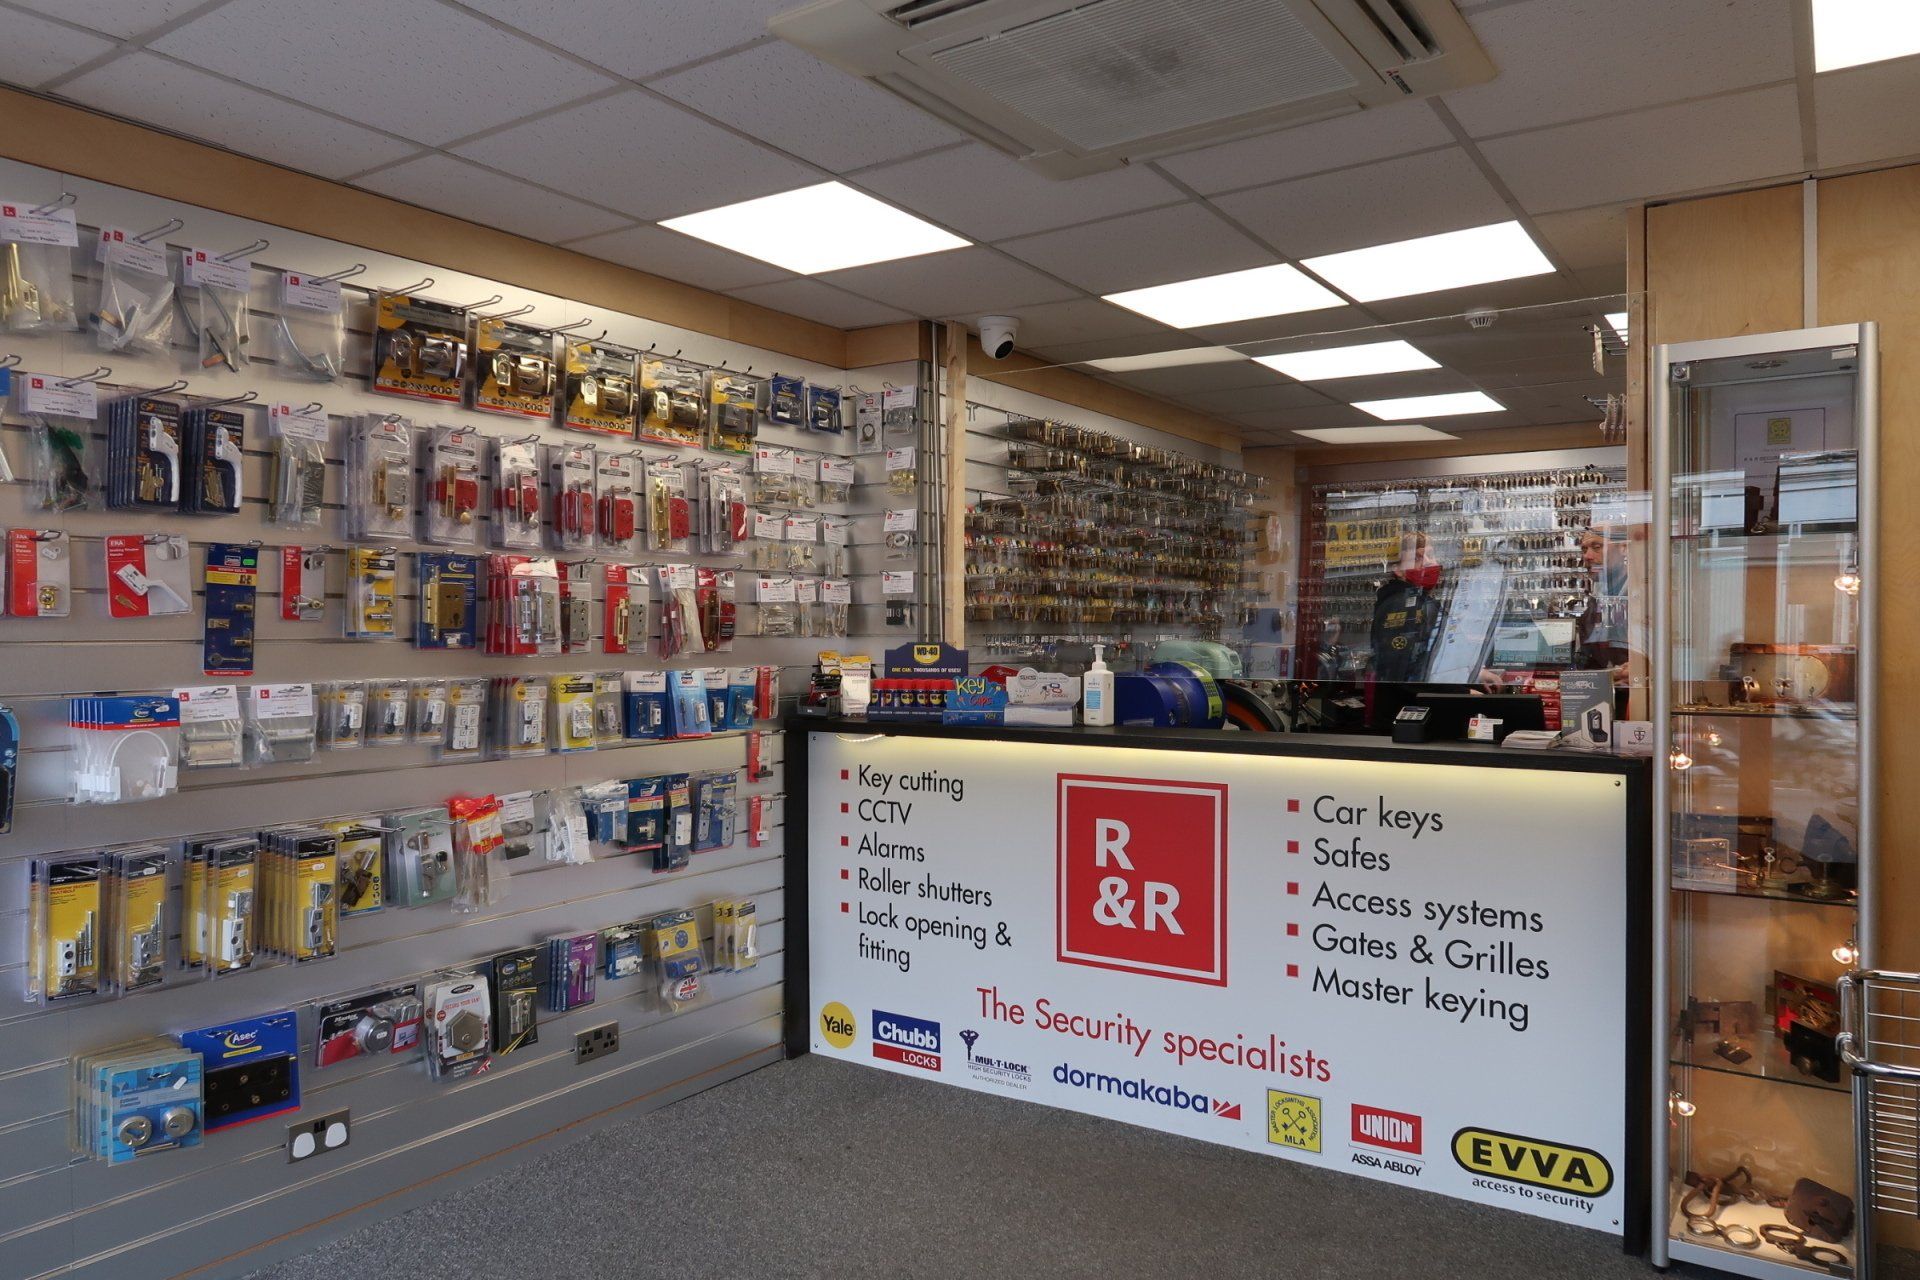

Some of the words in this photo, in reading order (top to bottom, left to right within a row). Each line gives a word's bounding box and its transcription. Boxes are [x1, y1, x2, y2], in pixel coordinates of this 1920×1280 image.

[916, 647, 938, 656] WD-40
[859, 764, 893, 795] Key
[899, 770, 964, 802] cutting
[858, 799, 912, 825] CCTV
[1313, 795, 1367, 825] Car
[1379, 796, 1443, 839] keys
[858, 831, 925, 862] Alarms
[1095, 818, 1135, 871] R
[1313, 837, 1391, 871] Safes
[859, 867, 911, 895] Roller
[918, 873, 992, 907] shutters
[1312, 881, 1412, 918] Access
[1424, 900, 1544, 932] systems
[859, 902, 899, 929] Lock
[905, 916, 987, 950] opening
[995, 922, 1012, 947] &
[859, 933, 910, 972] fitting
[1312, 923, 1397, 960] Gates
[1410, 934, 1434, 964] &
[1445, 939, 1550, 980] Grilles
[1312, 965, 1413, 1005] Master
[1425, 976, 1529, 1031] keying
[232, 1031, 257, 1044] Asec
[823, 1014, 854, 1036] Yale
[878, 1020, 938, 1049] Chubb
[977, 986, 1024, 1025] The
[1035, 998, 1152, 1057] Security
[1163, 1031, 1331, 1083] specialists
[902, 1051, 938, 1068] LOCKS
[967, 1064, 986, 1073] HIGH
[987, 1067, 1011, 1077] SECURITY
[1011, 1073, 1032, 1082] LOCKS
[972, 1074, 1005, 1086] AUTHORIZED
[1006, 1080, 1027, 1090] DEALER
[1053, 1063, 1209, 1114] dormakaba
[1284, 1134, 1306, 1146] MLA
[1359, 1114, 1413, 1143] UNION
[1352, 1153, 1382, 1169] ASSA
[1383, 1159, 1422, 1177] ABLOY
[1472, 1138, 1594, 1188] EVVA
[1472, 1177, 1516, 1195] access
[1519, 1186, 1534, 1198] to
[1536, 1190, 1594, 1213] security
